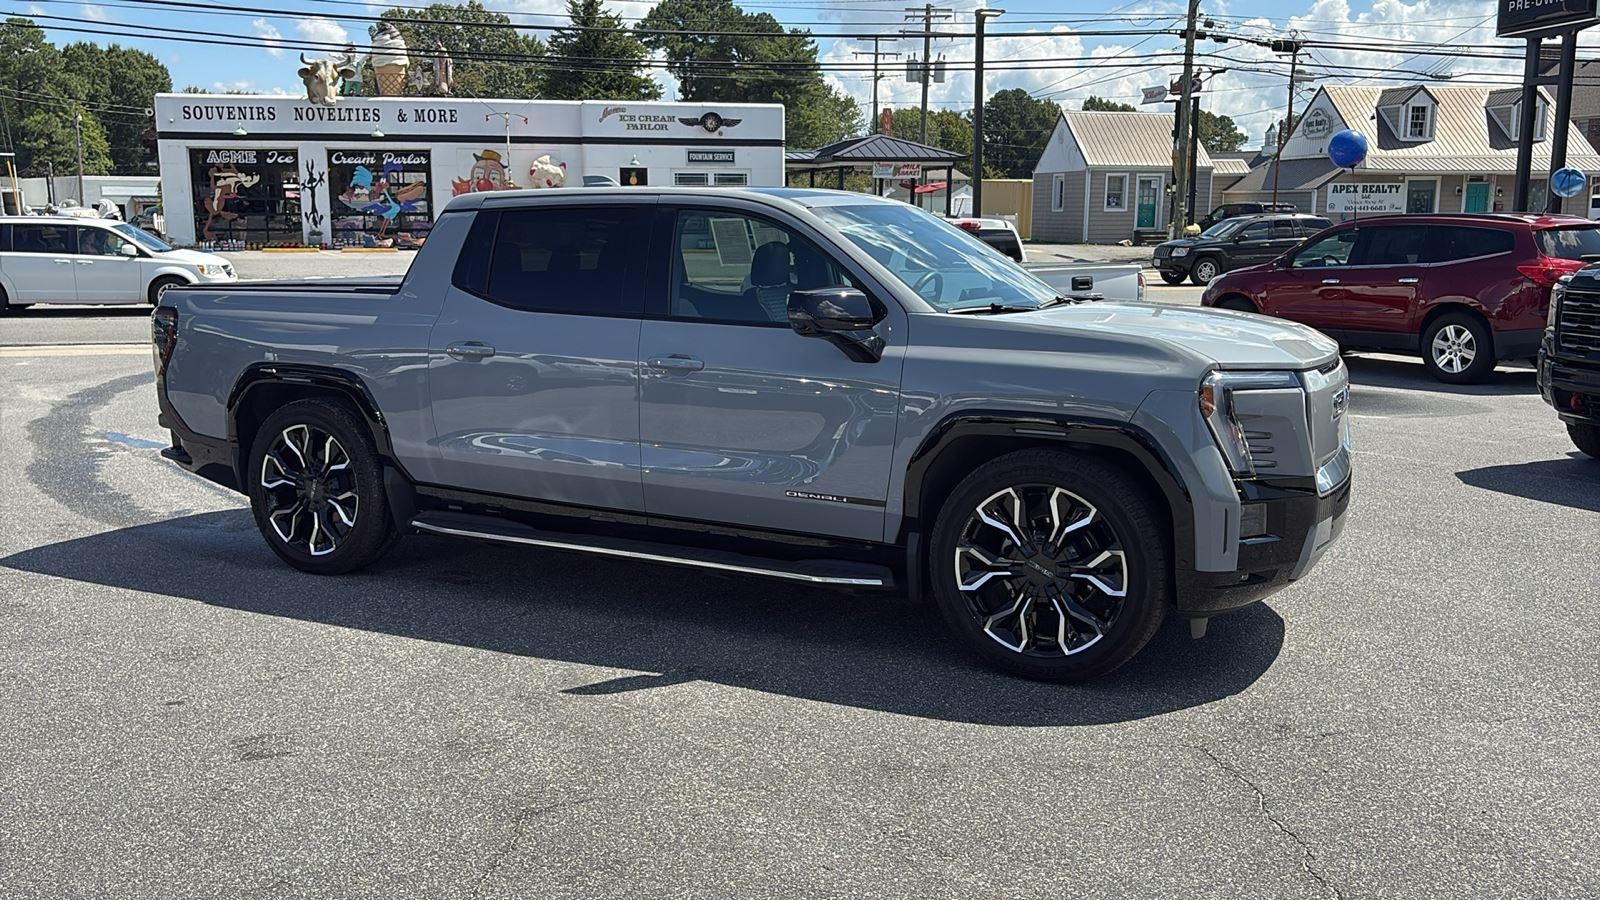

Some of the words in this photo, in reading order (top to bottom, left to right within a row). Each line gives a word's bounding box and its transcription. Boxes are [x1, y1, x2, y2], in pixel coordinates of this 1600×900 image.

[1508, 0, 1565, 12] PRE-O
[182, 105, 276, 120] SOUVENIRS
[294, 107, 381, 122] NOVELTIES
[397, 108, 408, 122] &
[414, 109, 458, 123] MORE
[619, 114, 636, 122] ICE
[638, 115, 676, 123] CREAM
[626, 123, 669, 131] PARLOR
[206, 150, 257, 164] ACME
[266, 151, 296, 164] Ice
[331, 152, 377, 164] Cream
[382, 152, 428, 165] Parlor
[689, 153, 713, 161] FOUNTAIN
[713, 153, 734, 161] SERVICE
[1332, 184, 1359, 194] APEX
[1361, 184, 1401, 194] REALTY
[786, 491, 846, 502] DENALI
